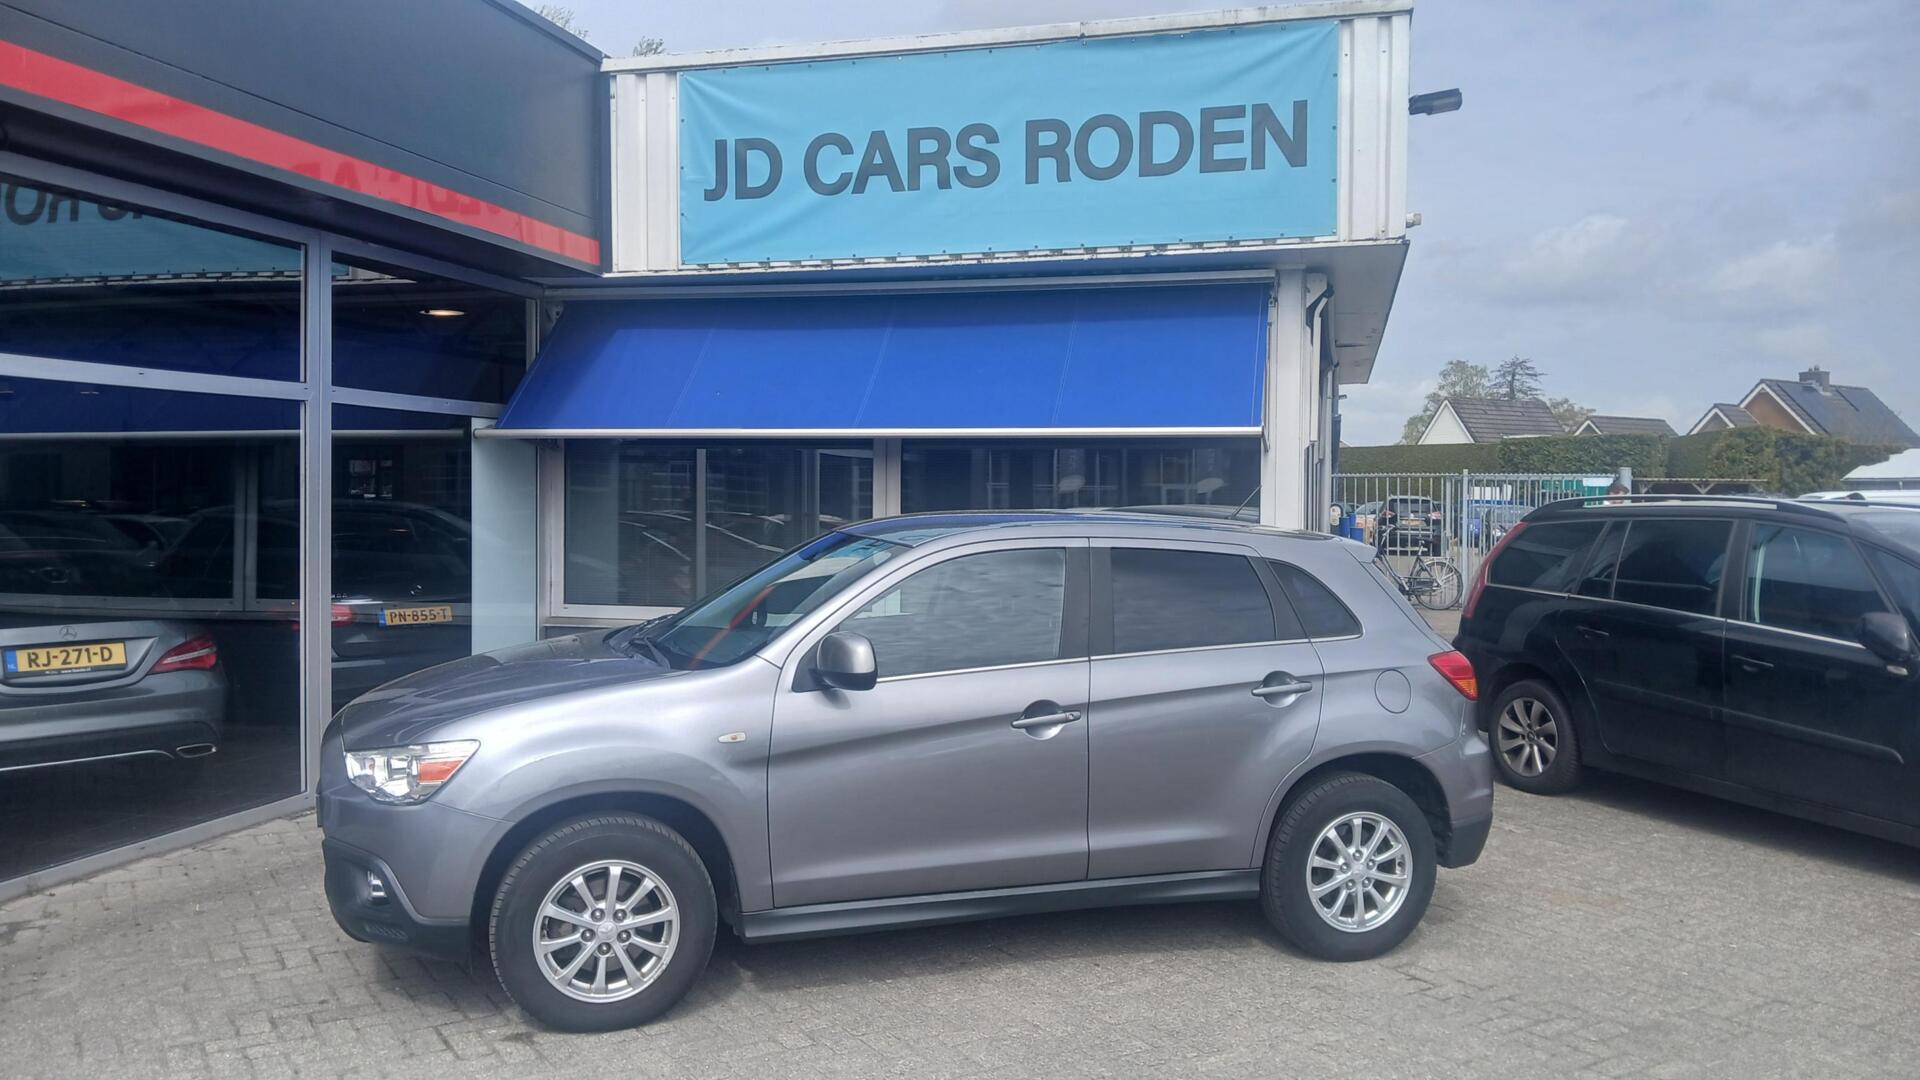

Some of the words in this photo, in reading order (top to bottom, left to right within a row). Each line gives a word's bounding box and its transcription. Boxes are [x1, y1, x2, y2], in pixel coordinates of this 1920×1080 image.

[704, 137, 783, 201] JD
[803, 122, 1001, 196] CARS
[1025, 99, 1308, 184] RODEN
[389, 608, 447, 623] PN-855-T
[27, 646, 113, 668] RJ-271-D
